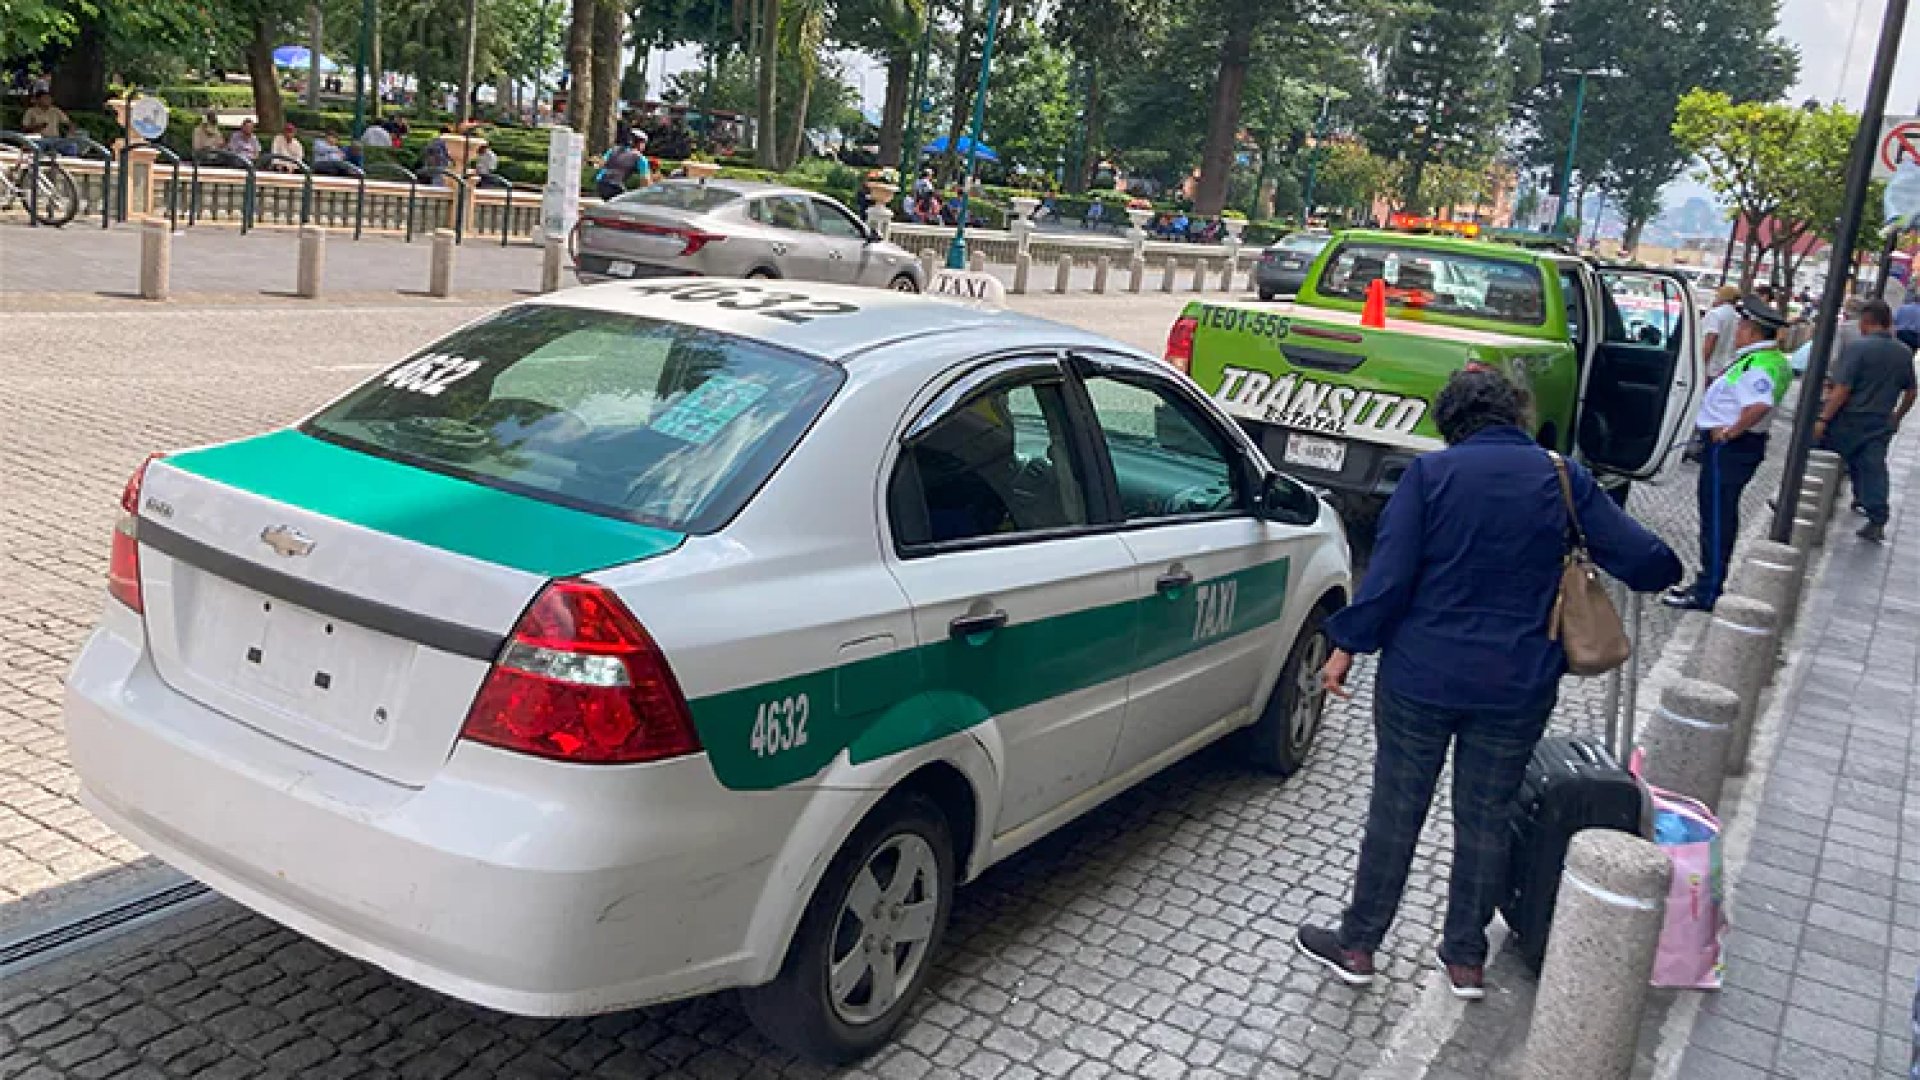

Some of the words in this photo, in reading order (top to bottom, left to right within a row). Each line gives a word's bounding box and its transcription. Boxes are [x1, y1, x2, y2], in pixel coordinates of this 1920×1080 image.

[632, 282, 861, 326] 4632
[936, 273, 986, 299] TAXI
[383, 353, 481, 397] 4632
[1215, 364, 1428, 434] TRÁNSITO
[1263, 402, 1345, 433] ESTATAL
[1192, 579, 1238, 641] TAXI
[750, 693, 809, 758] 4632
